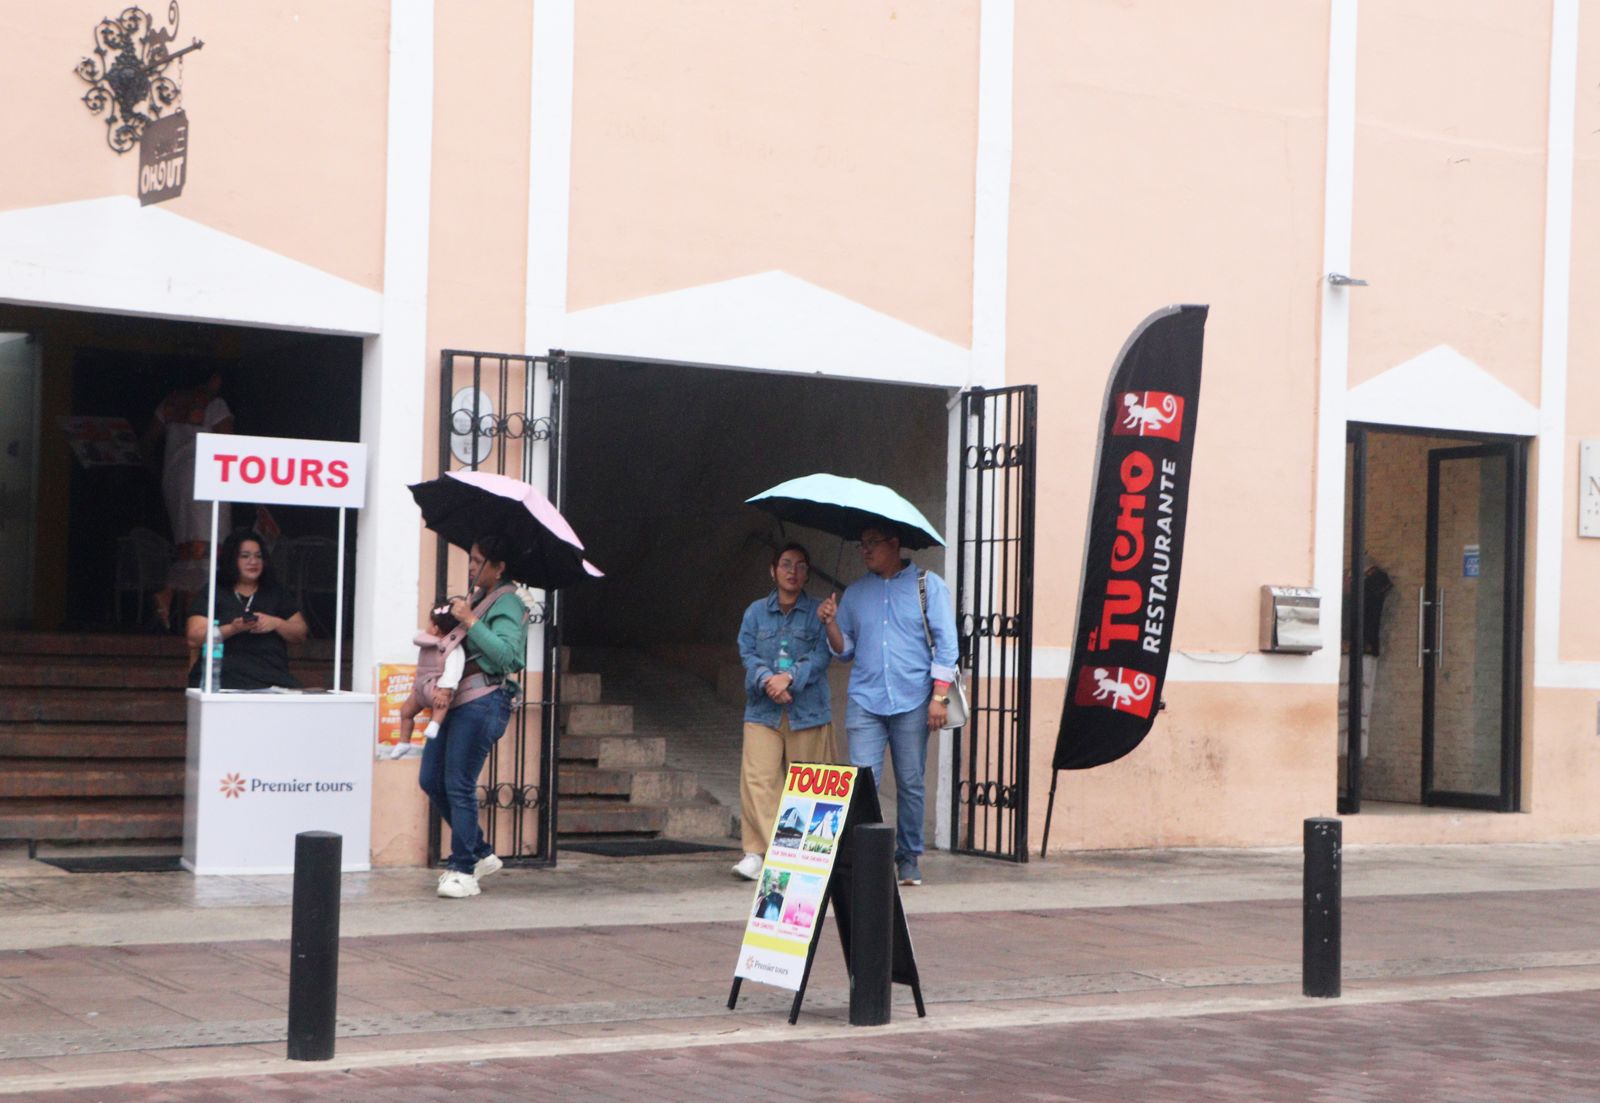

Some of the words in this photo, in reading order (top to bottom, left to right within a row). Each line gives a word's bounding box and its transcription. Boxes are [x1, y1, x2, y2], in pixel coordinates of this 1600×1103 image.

[213, 454, 350, 489] TOURS
[1099, 450, 1155, 651] TUCHO
[1142, 458, 1177, 654] RESTAURANTE
[1087, 625, 1099, 652] EL
[251, 778, 313, 792] Premier
[315, 781, 353, 792] tours
[788, 765, 853, 798] TOURS
[754, 960, 775, 972] Premier
[775, 966, 789, 975] tours
